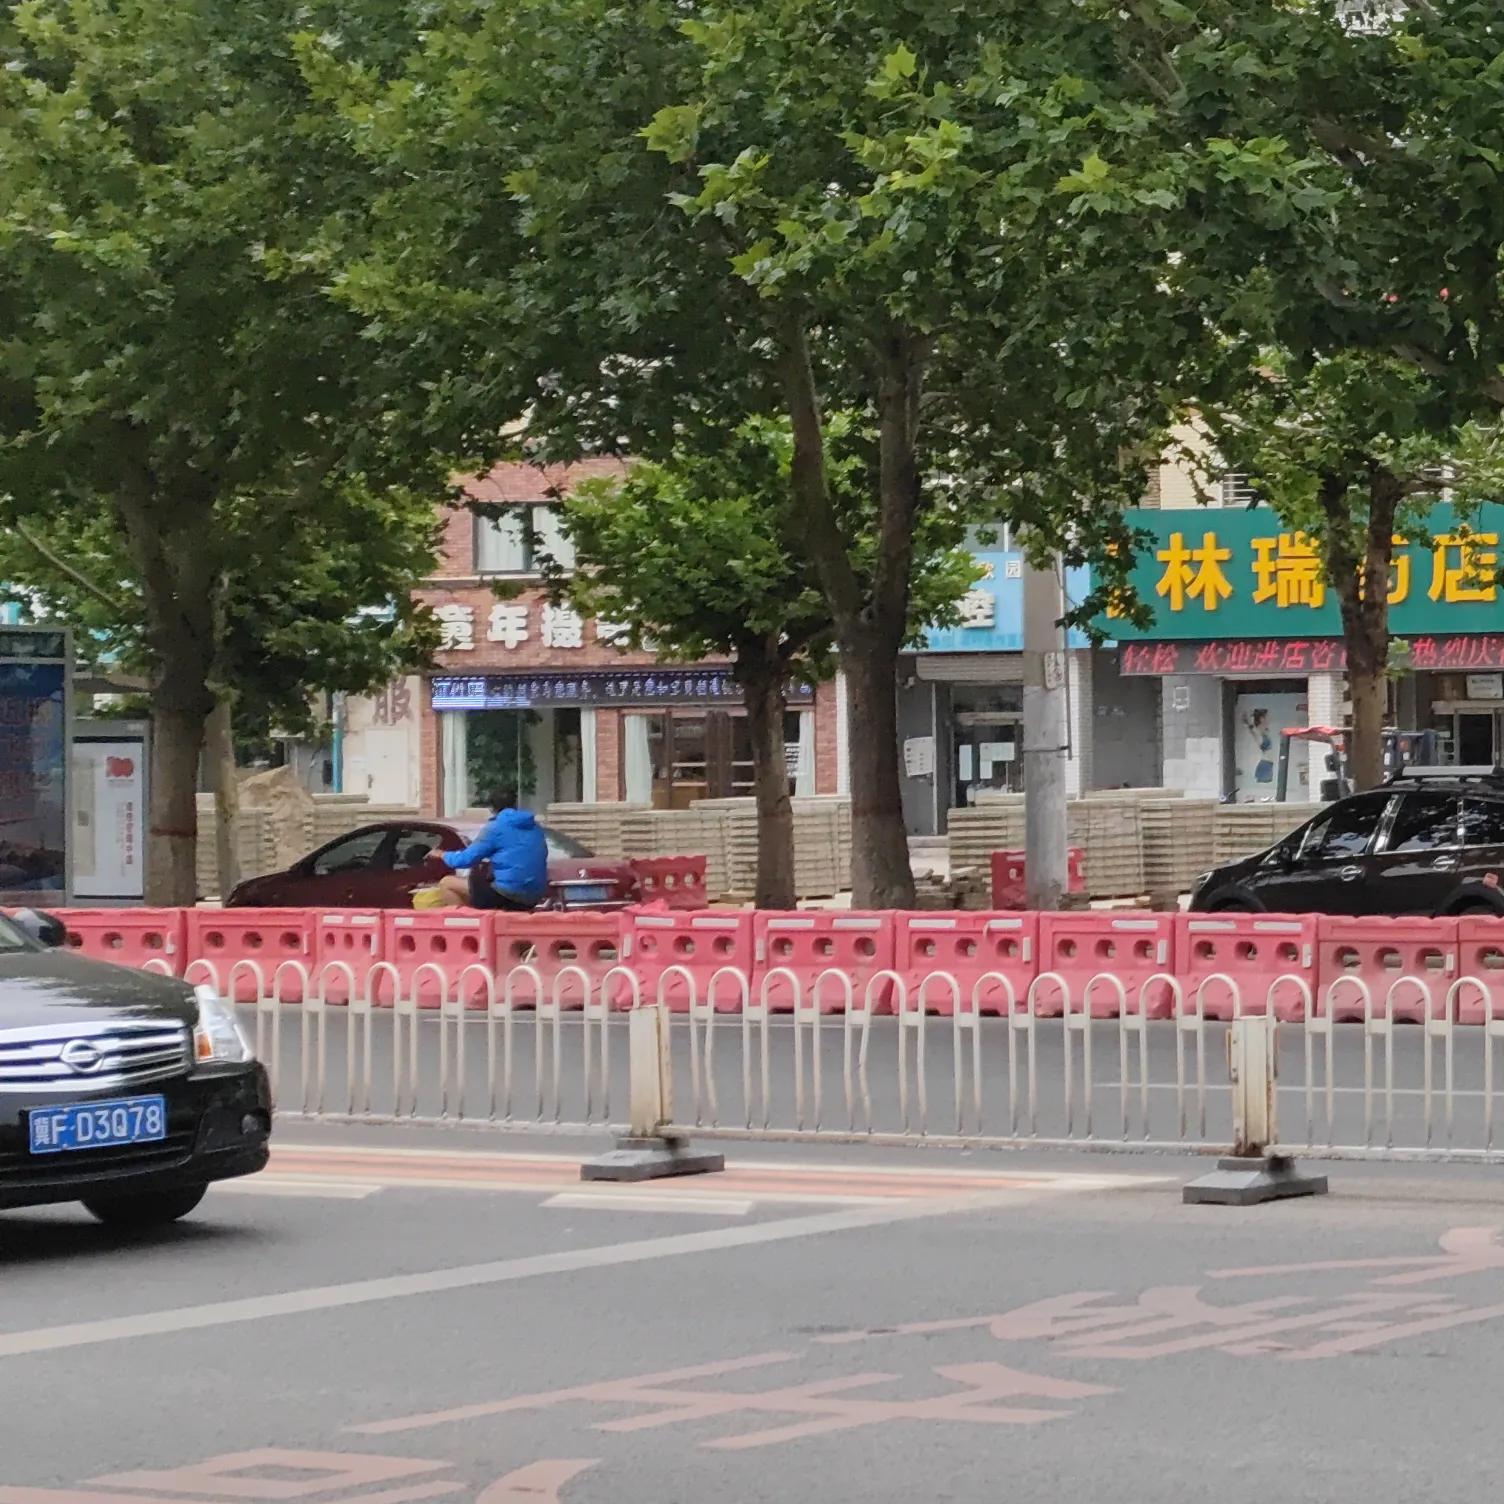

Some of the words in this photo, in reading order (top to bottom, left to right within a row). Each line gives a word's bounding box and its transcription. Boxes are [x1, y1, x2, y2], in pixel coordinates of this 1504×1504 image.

[1193, 639, 1348, 671] 欢迎进店咨
